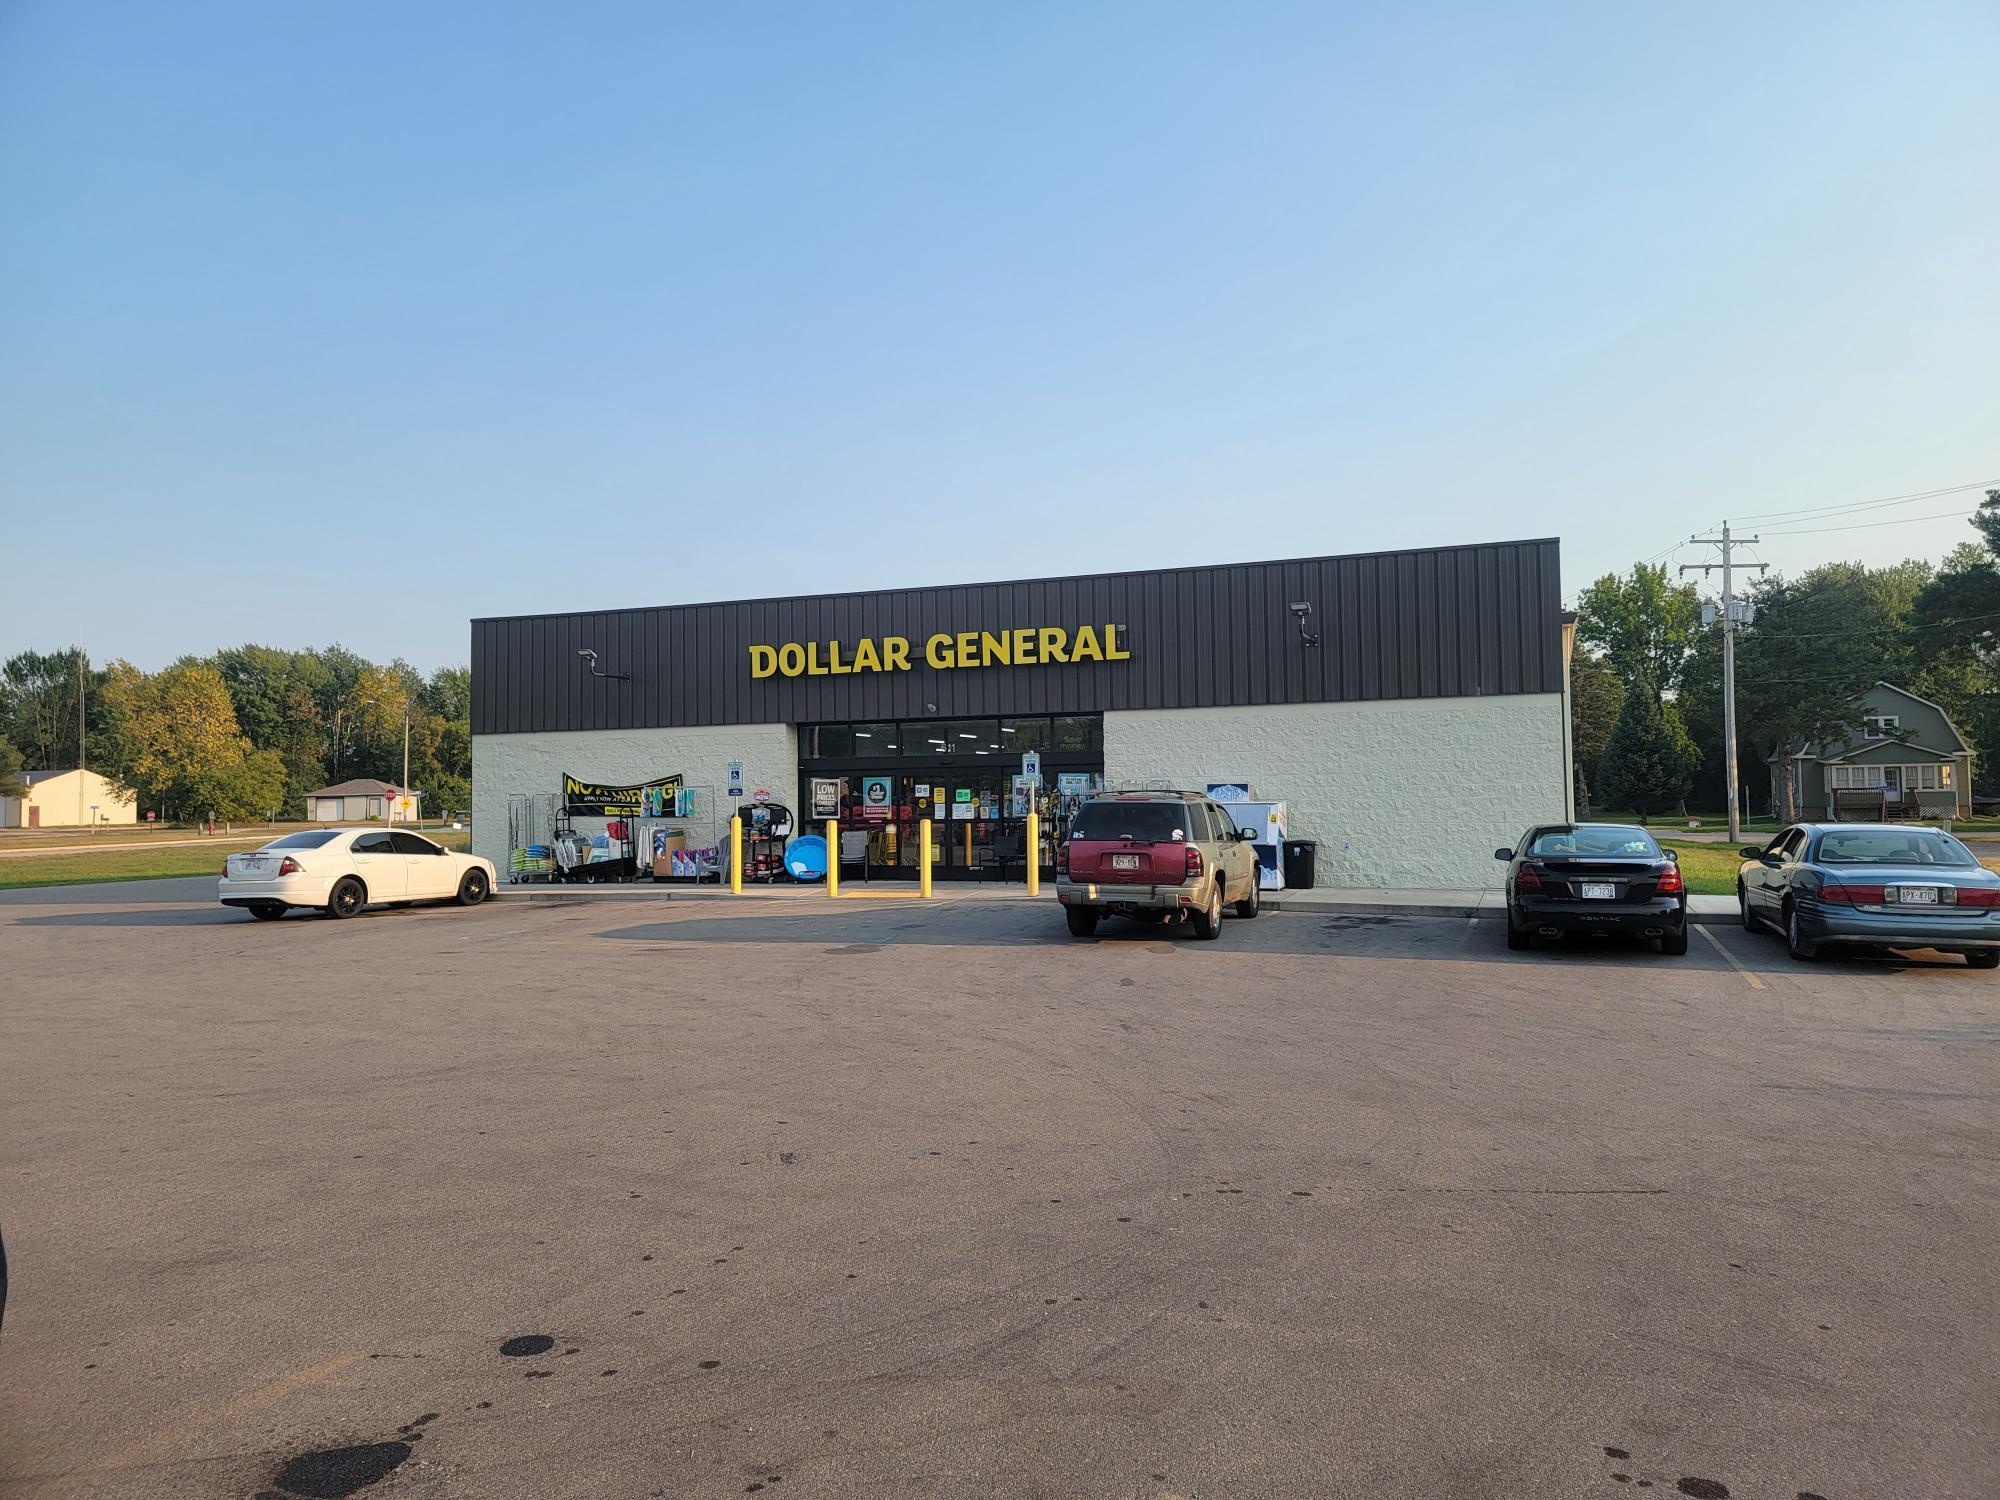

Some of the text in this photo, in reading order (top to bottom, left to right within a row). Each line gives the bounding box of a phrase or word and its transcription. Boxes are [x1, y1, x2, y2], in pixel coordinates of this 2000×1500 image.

[748, 624, 1131, 679] DOLLAR GENERAL
[817, 784, 836, 794] LOW
